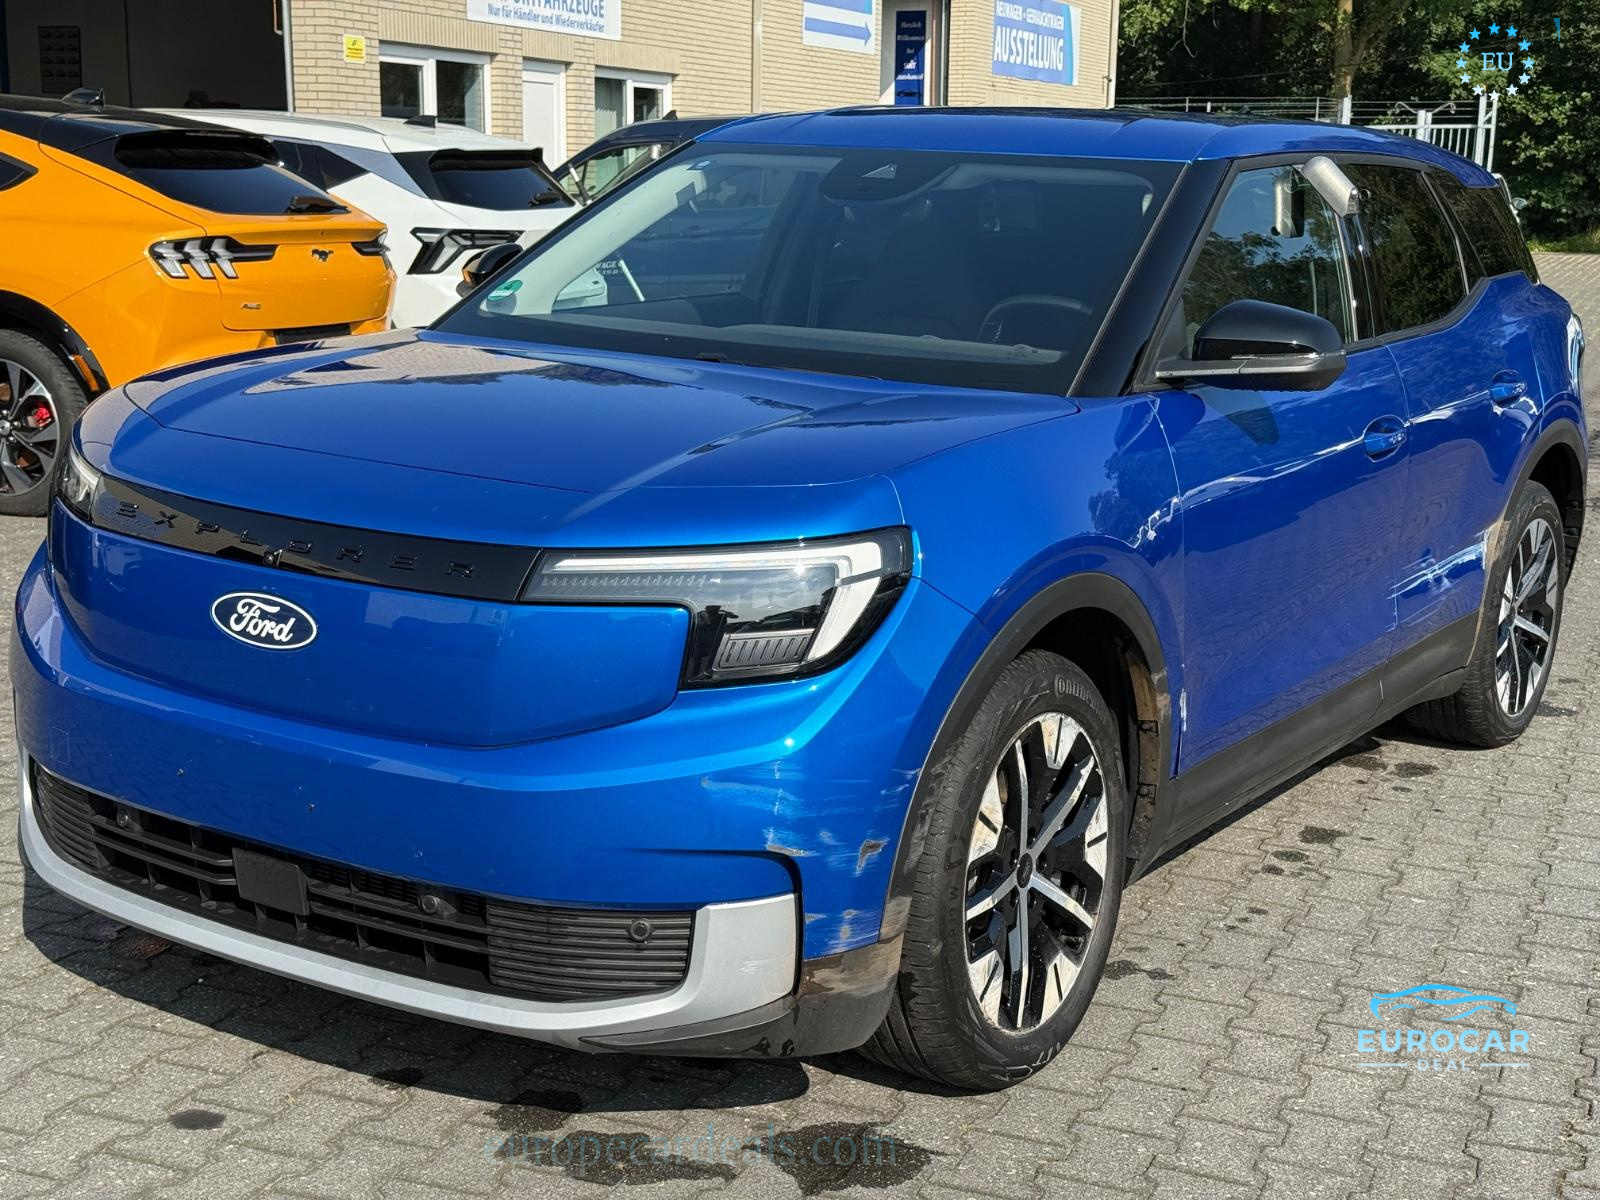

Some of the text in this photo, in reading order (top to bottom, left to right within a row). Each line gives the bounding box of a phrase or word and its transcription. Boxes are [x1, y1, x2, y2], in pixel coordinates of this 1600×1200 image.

[487, 3, 605, 32] Nur für Händler und Wiederverkäufer
[993, 25, 1064, 71] AUSSTELLUNG
[116, 501, 474, 578] EXPLORER
[229, 598, 297, 642] Ford
